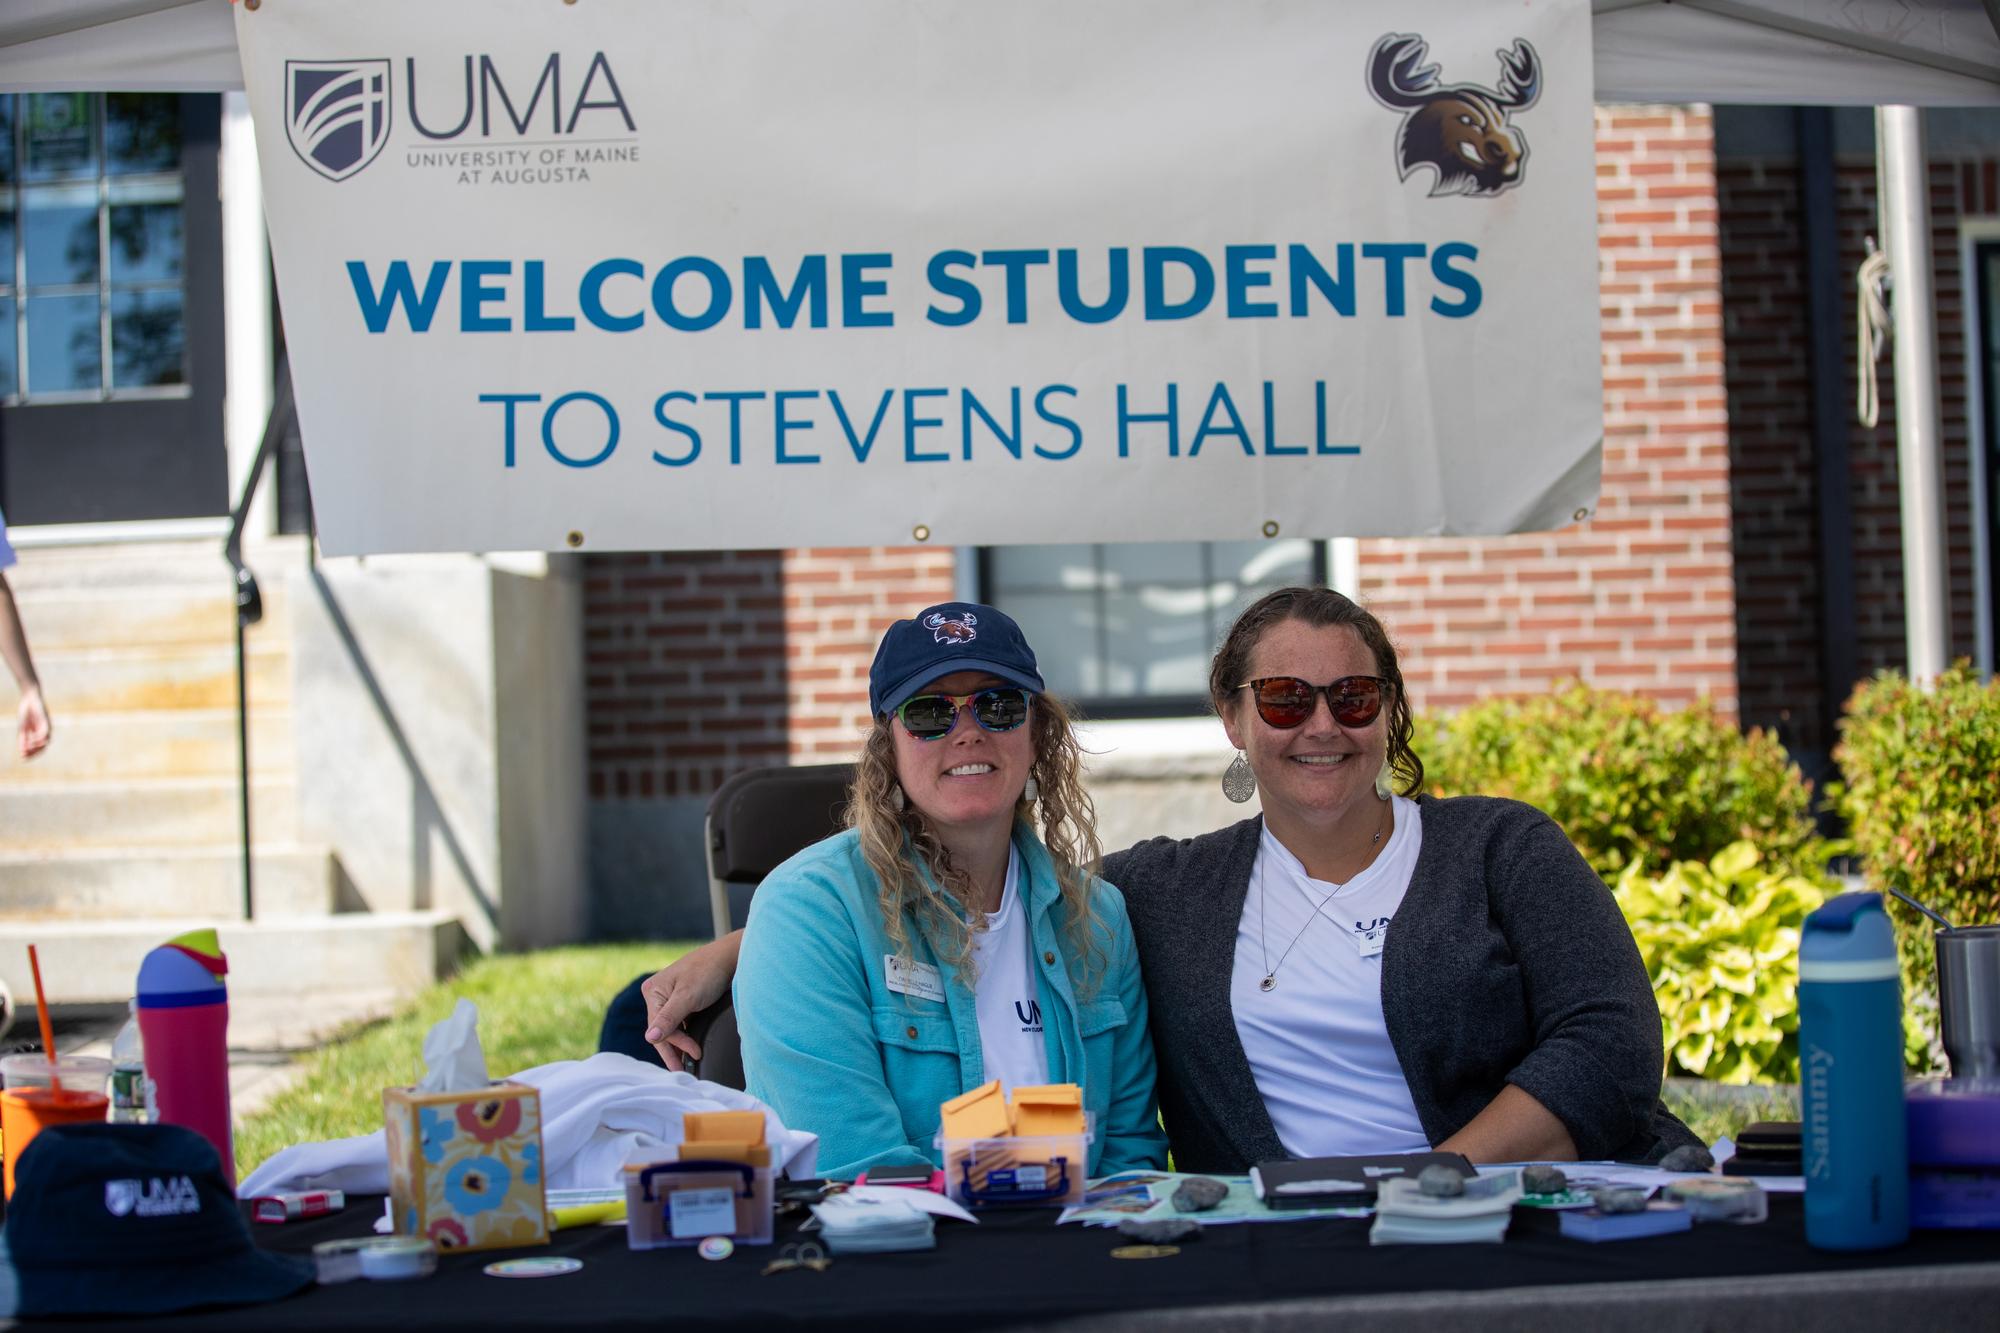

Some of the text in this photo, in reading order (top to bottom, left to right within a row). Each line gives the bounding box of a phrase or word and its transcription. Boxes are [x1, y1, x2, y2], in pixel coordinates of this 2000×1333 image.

[406, 50, 637, 141] UMA
[406, 146, 640, 168] UNIVERSITY OF MAINE
[457, 167, 591, 185] AT AUGUSTA
[345, 242, 1483, 333] WELCOME STUDENTS
[478, 380, 1361, 468] TO STEVENS HALL
